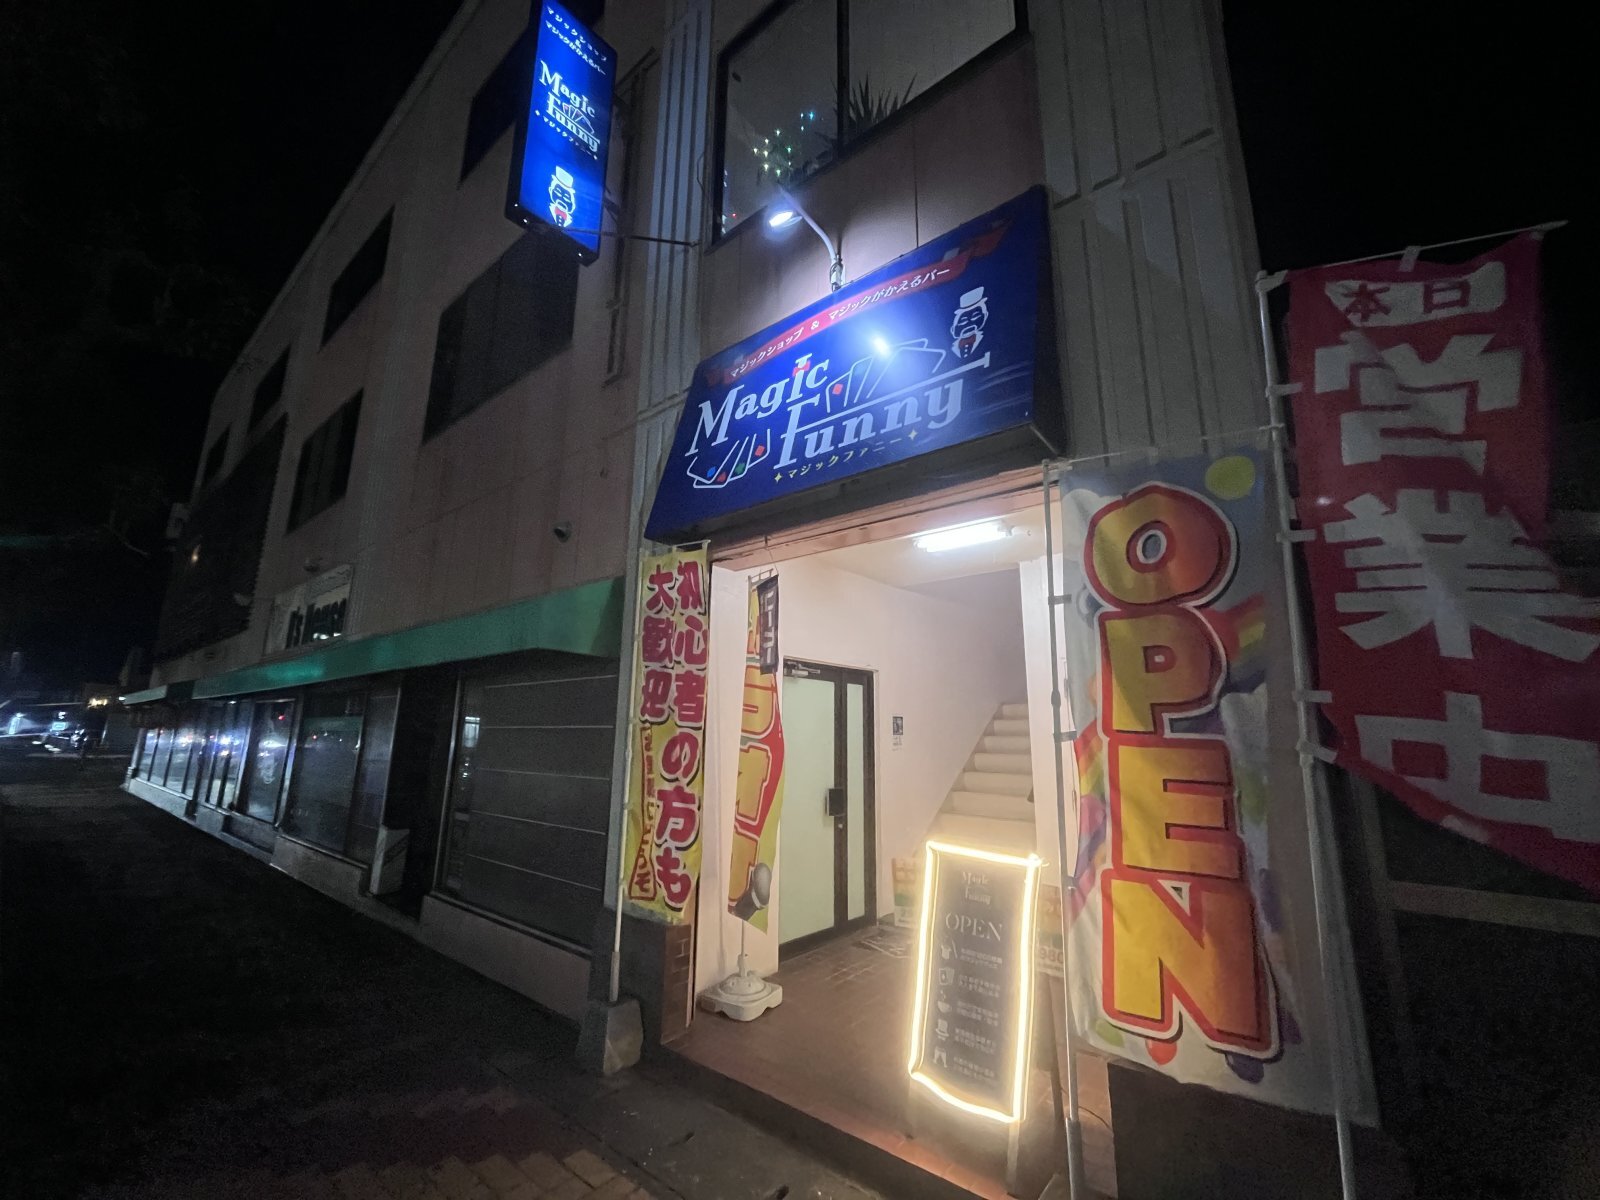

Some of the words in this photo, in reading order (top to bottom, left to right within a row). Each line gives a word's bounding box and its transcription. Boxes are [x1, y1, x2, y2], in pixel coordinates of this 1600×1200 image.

[539, 60, 596, 118] Magic
[546, 91, 601, 153] Funny
[730, 326, 805, 378] マジックショップ
[810, 319, 820, 331] &
[828, 268, 951, 321] マジックがかえるバー
[1345, 276, 1472, 322] 本日
[685, 353, 830, 457] Magic
[773, 358, 986, 470] Funny
[788, 437, 902, 479] マジックファニー
[1314, 331, 1600, 844] 営業中
[1085, 482, 1279, 1057] OPEN
[945, 913, 1003, 942] OPEN
